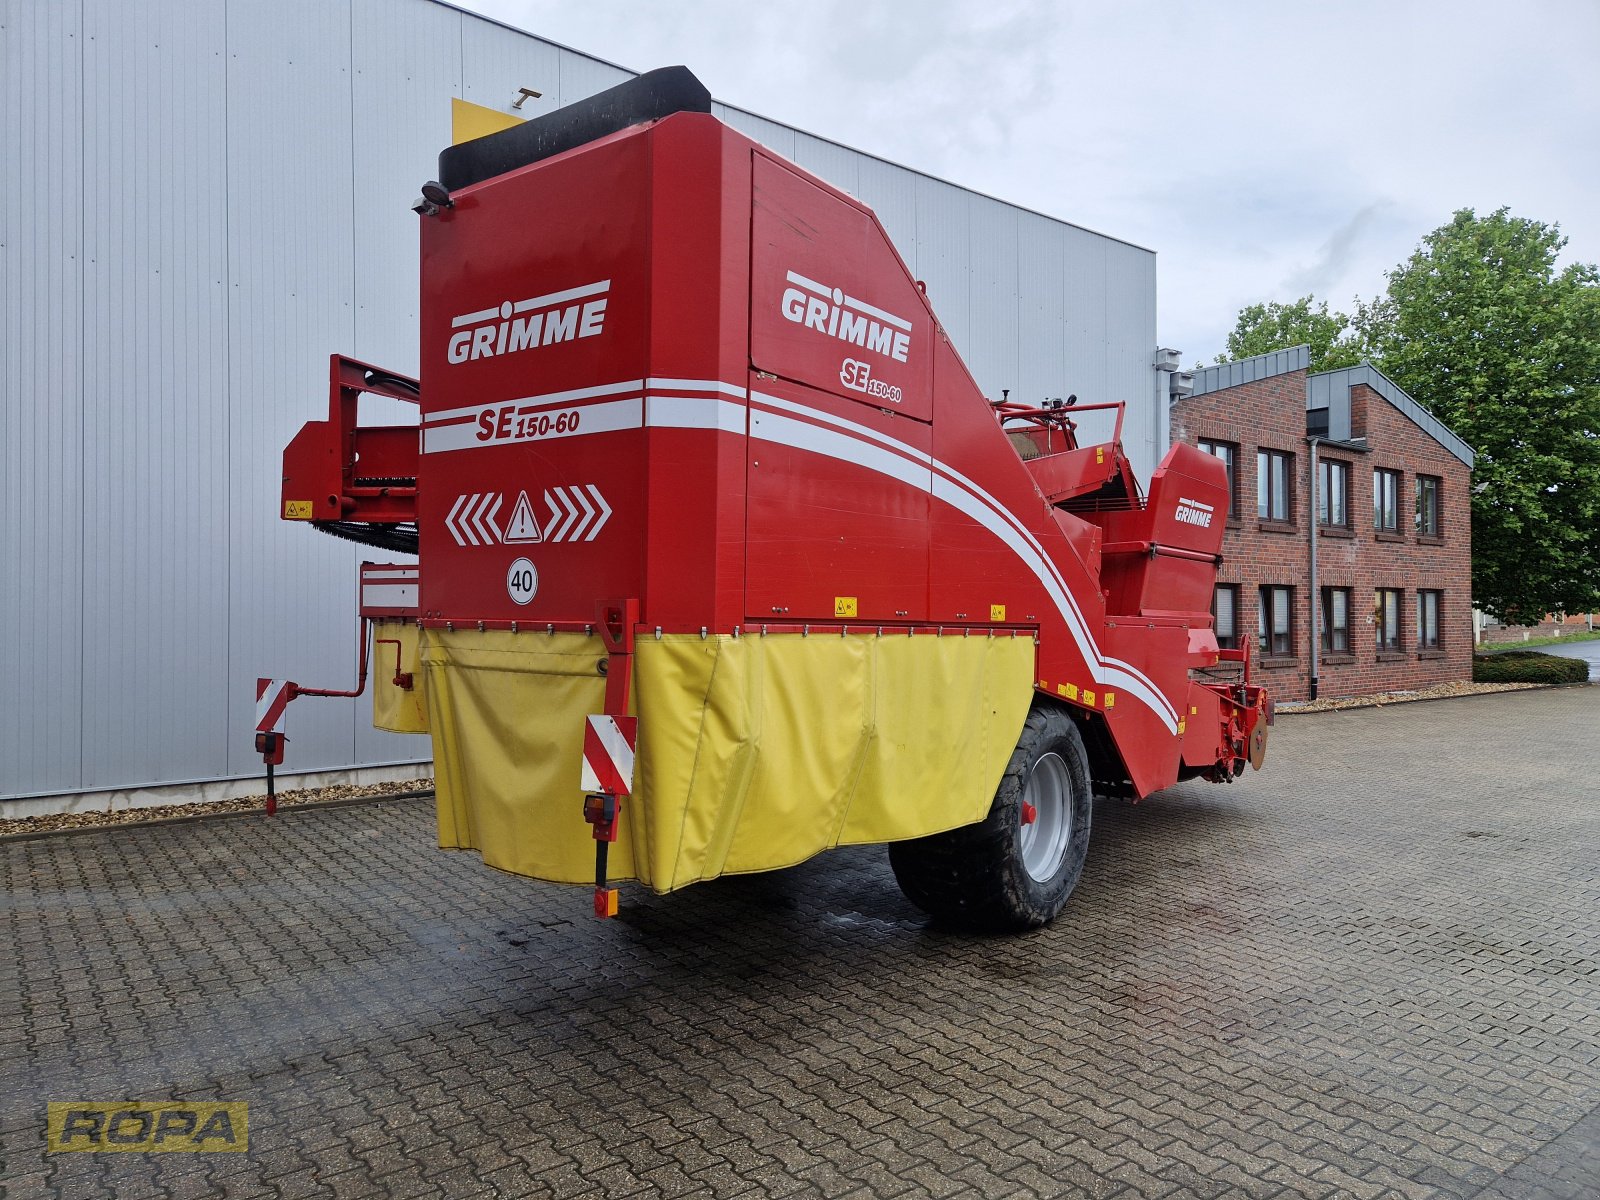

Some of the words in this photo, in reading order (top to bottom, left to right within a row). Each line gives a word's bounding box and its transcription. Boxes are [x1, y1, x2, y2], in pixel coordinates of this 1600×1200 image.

[447, 298, 608, 365] GRIMME
[781, 287, 911, 363] GRIMME
[842, 361, 869, 389] SE
[869, 381, 901, 402] 150-60
[475, 405, 516, 441] SE
[514, 410, 580, 438] 150-60
[1175, 503, 1213, 528] GRIMME
[511, 570, 532, 593] 40
